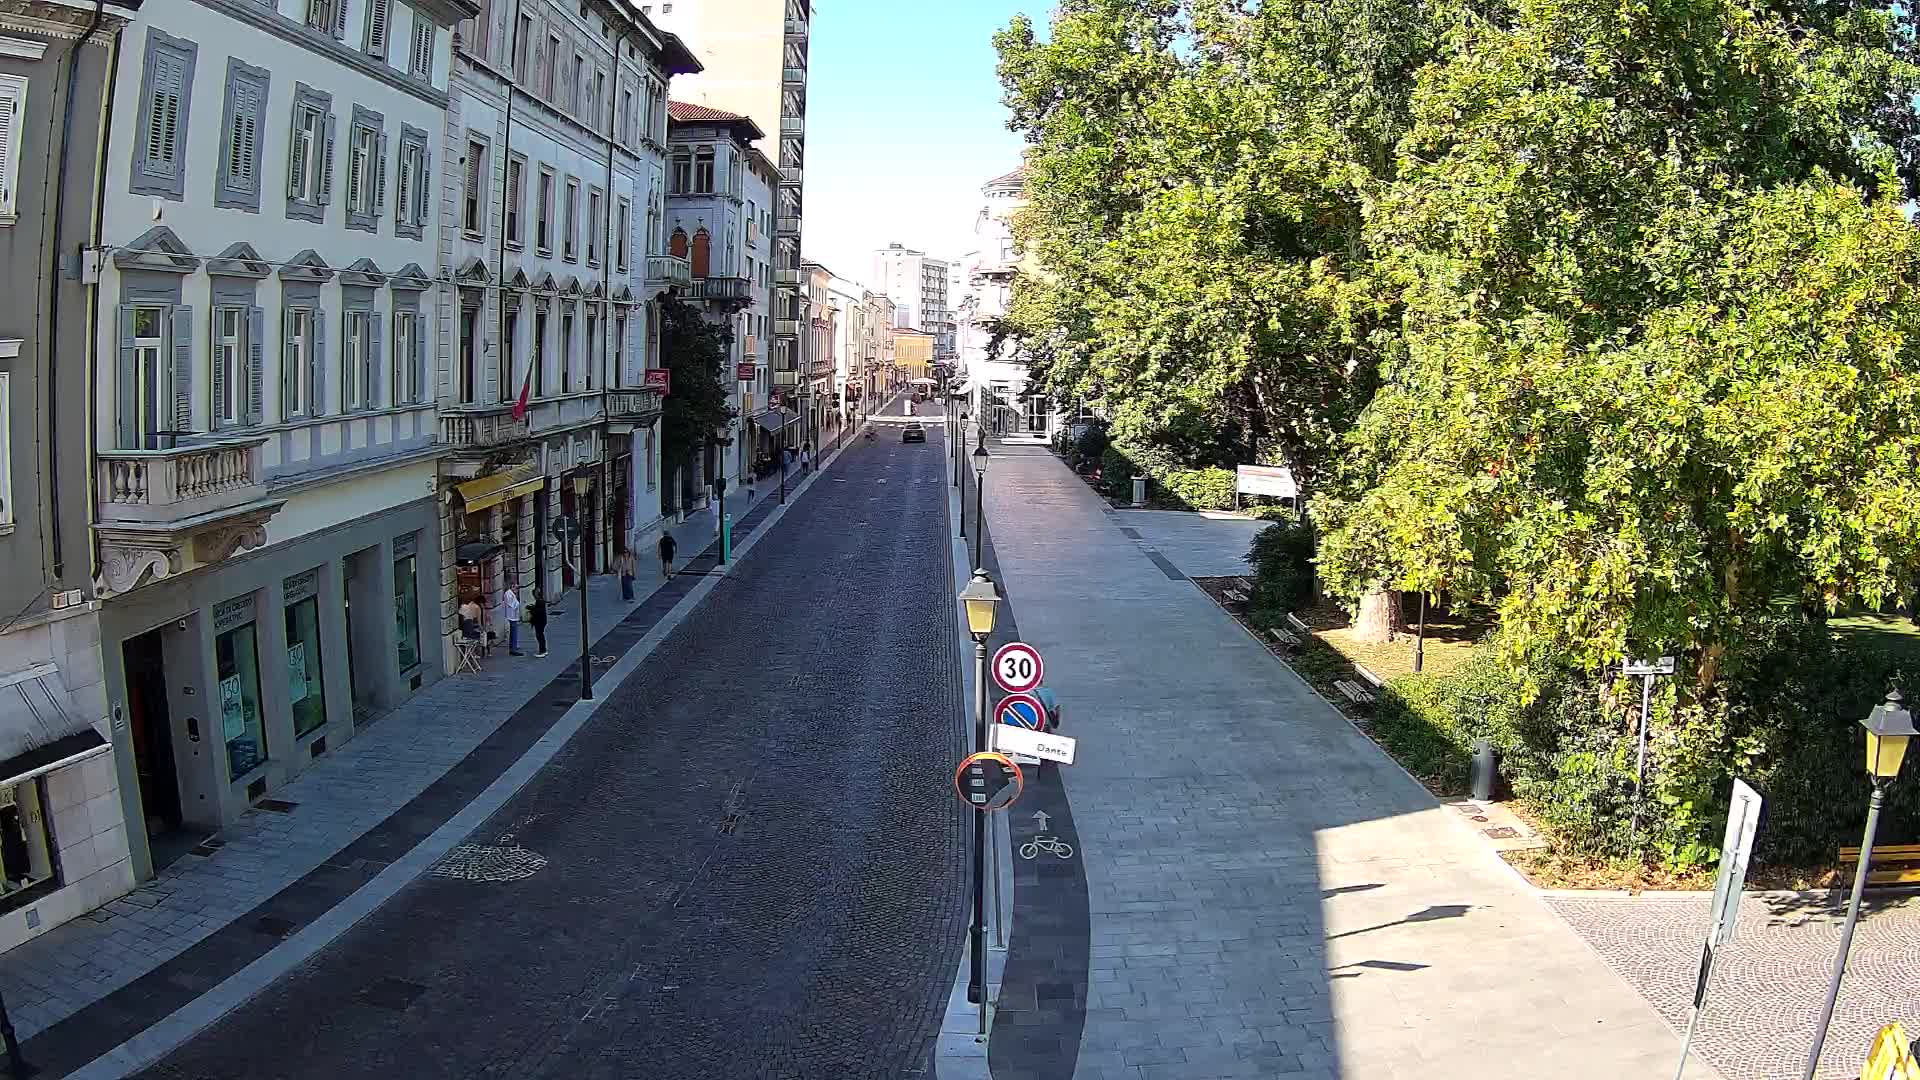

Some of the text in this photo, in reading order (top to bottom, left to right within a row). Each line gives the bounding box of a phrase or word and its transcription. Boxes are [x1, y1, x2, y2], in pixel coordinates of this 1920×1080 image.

[1005, 658, 1032, 679] 30
[221, 677, 240, 700] 130
[1036, 743, 1068, 757] Dante
